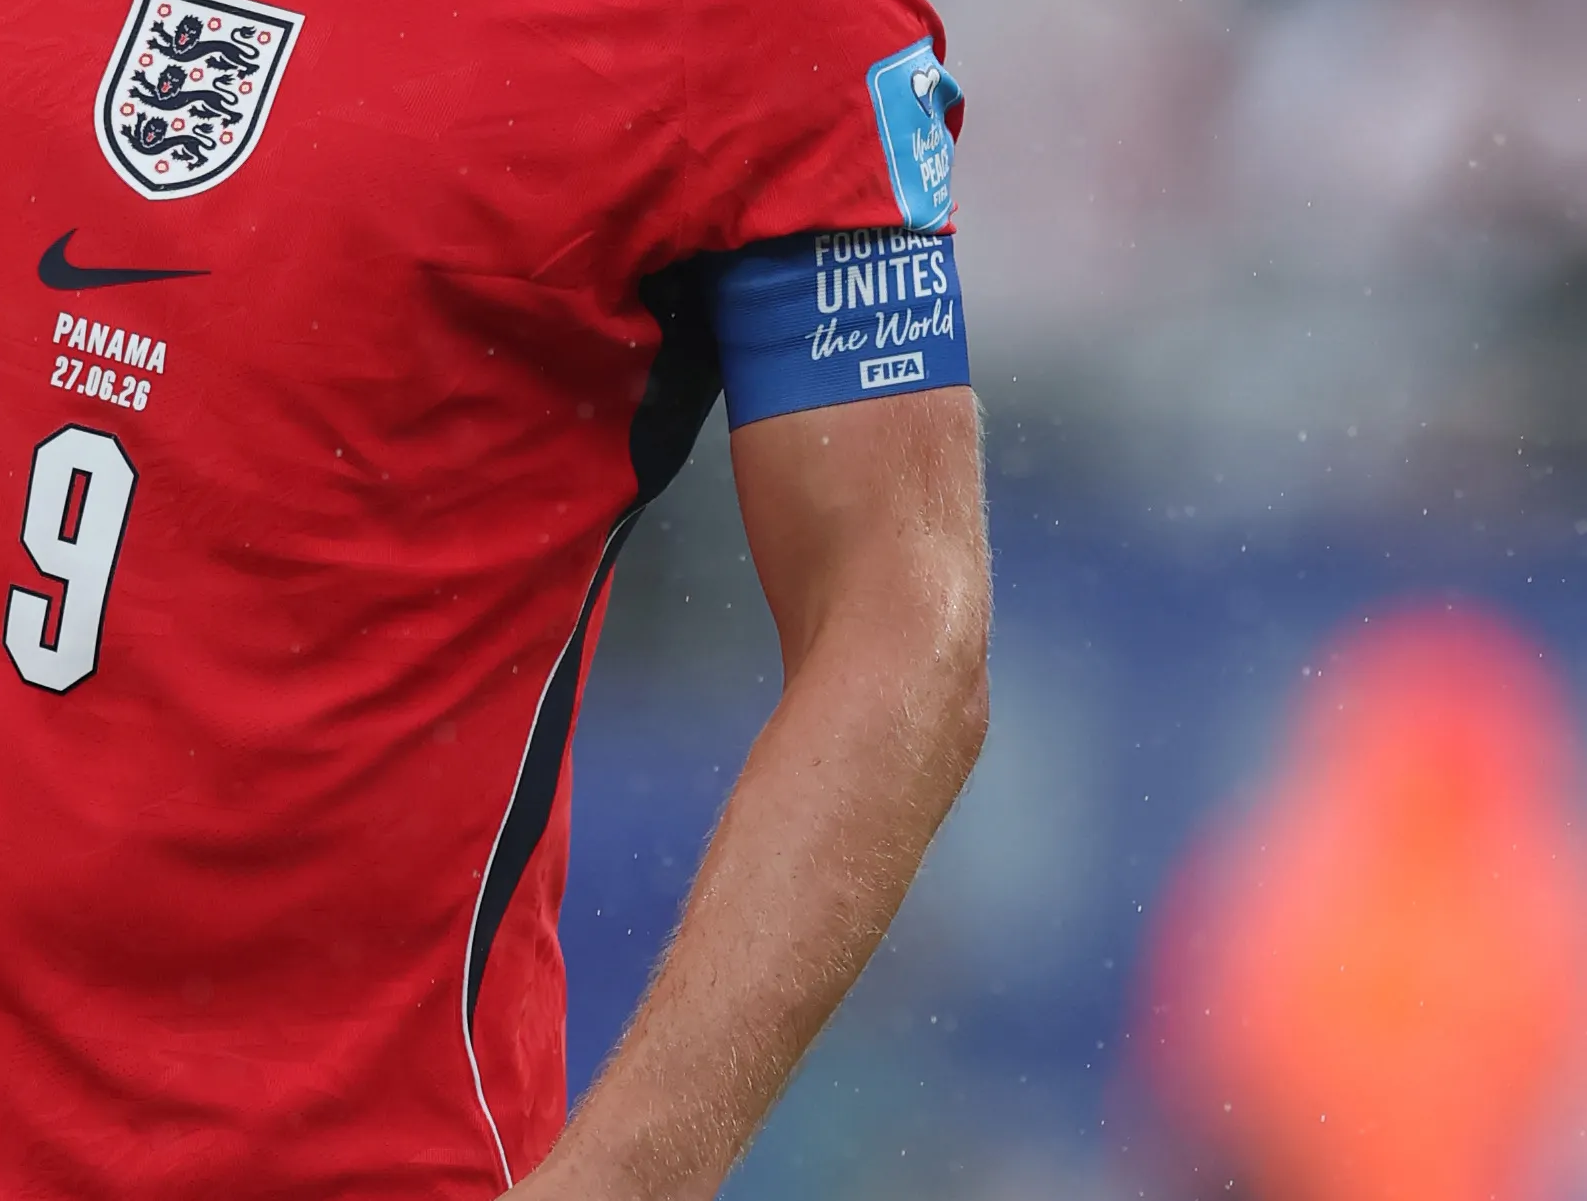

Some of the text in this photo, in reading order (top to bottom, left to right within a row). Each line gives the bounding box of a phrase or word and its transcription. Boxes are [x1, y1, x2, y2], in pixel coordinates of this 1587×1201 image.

[920, 144, 949, 192] PEAC
[817, 250, 948, 314] UNITES
[52, 311, 167, 375] PANAMA
[805, 298, 954, 360] the World
[50, 355, 151, 412] 27.06.26
[866, 358, 921, 383] FIFA
[3, 422, 139, 696] 9
